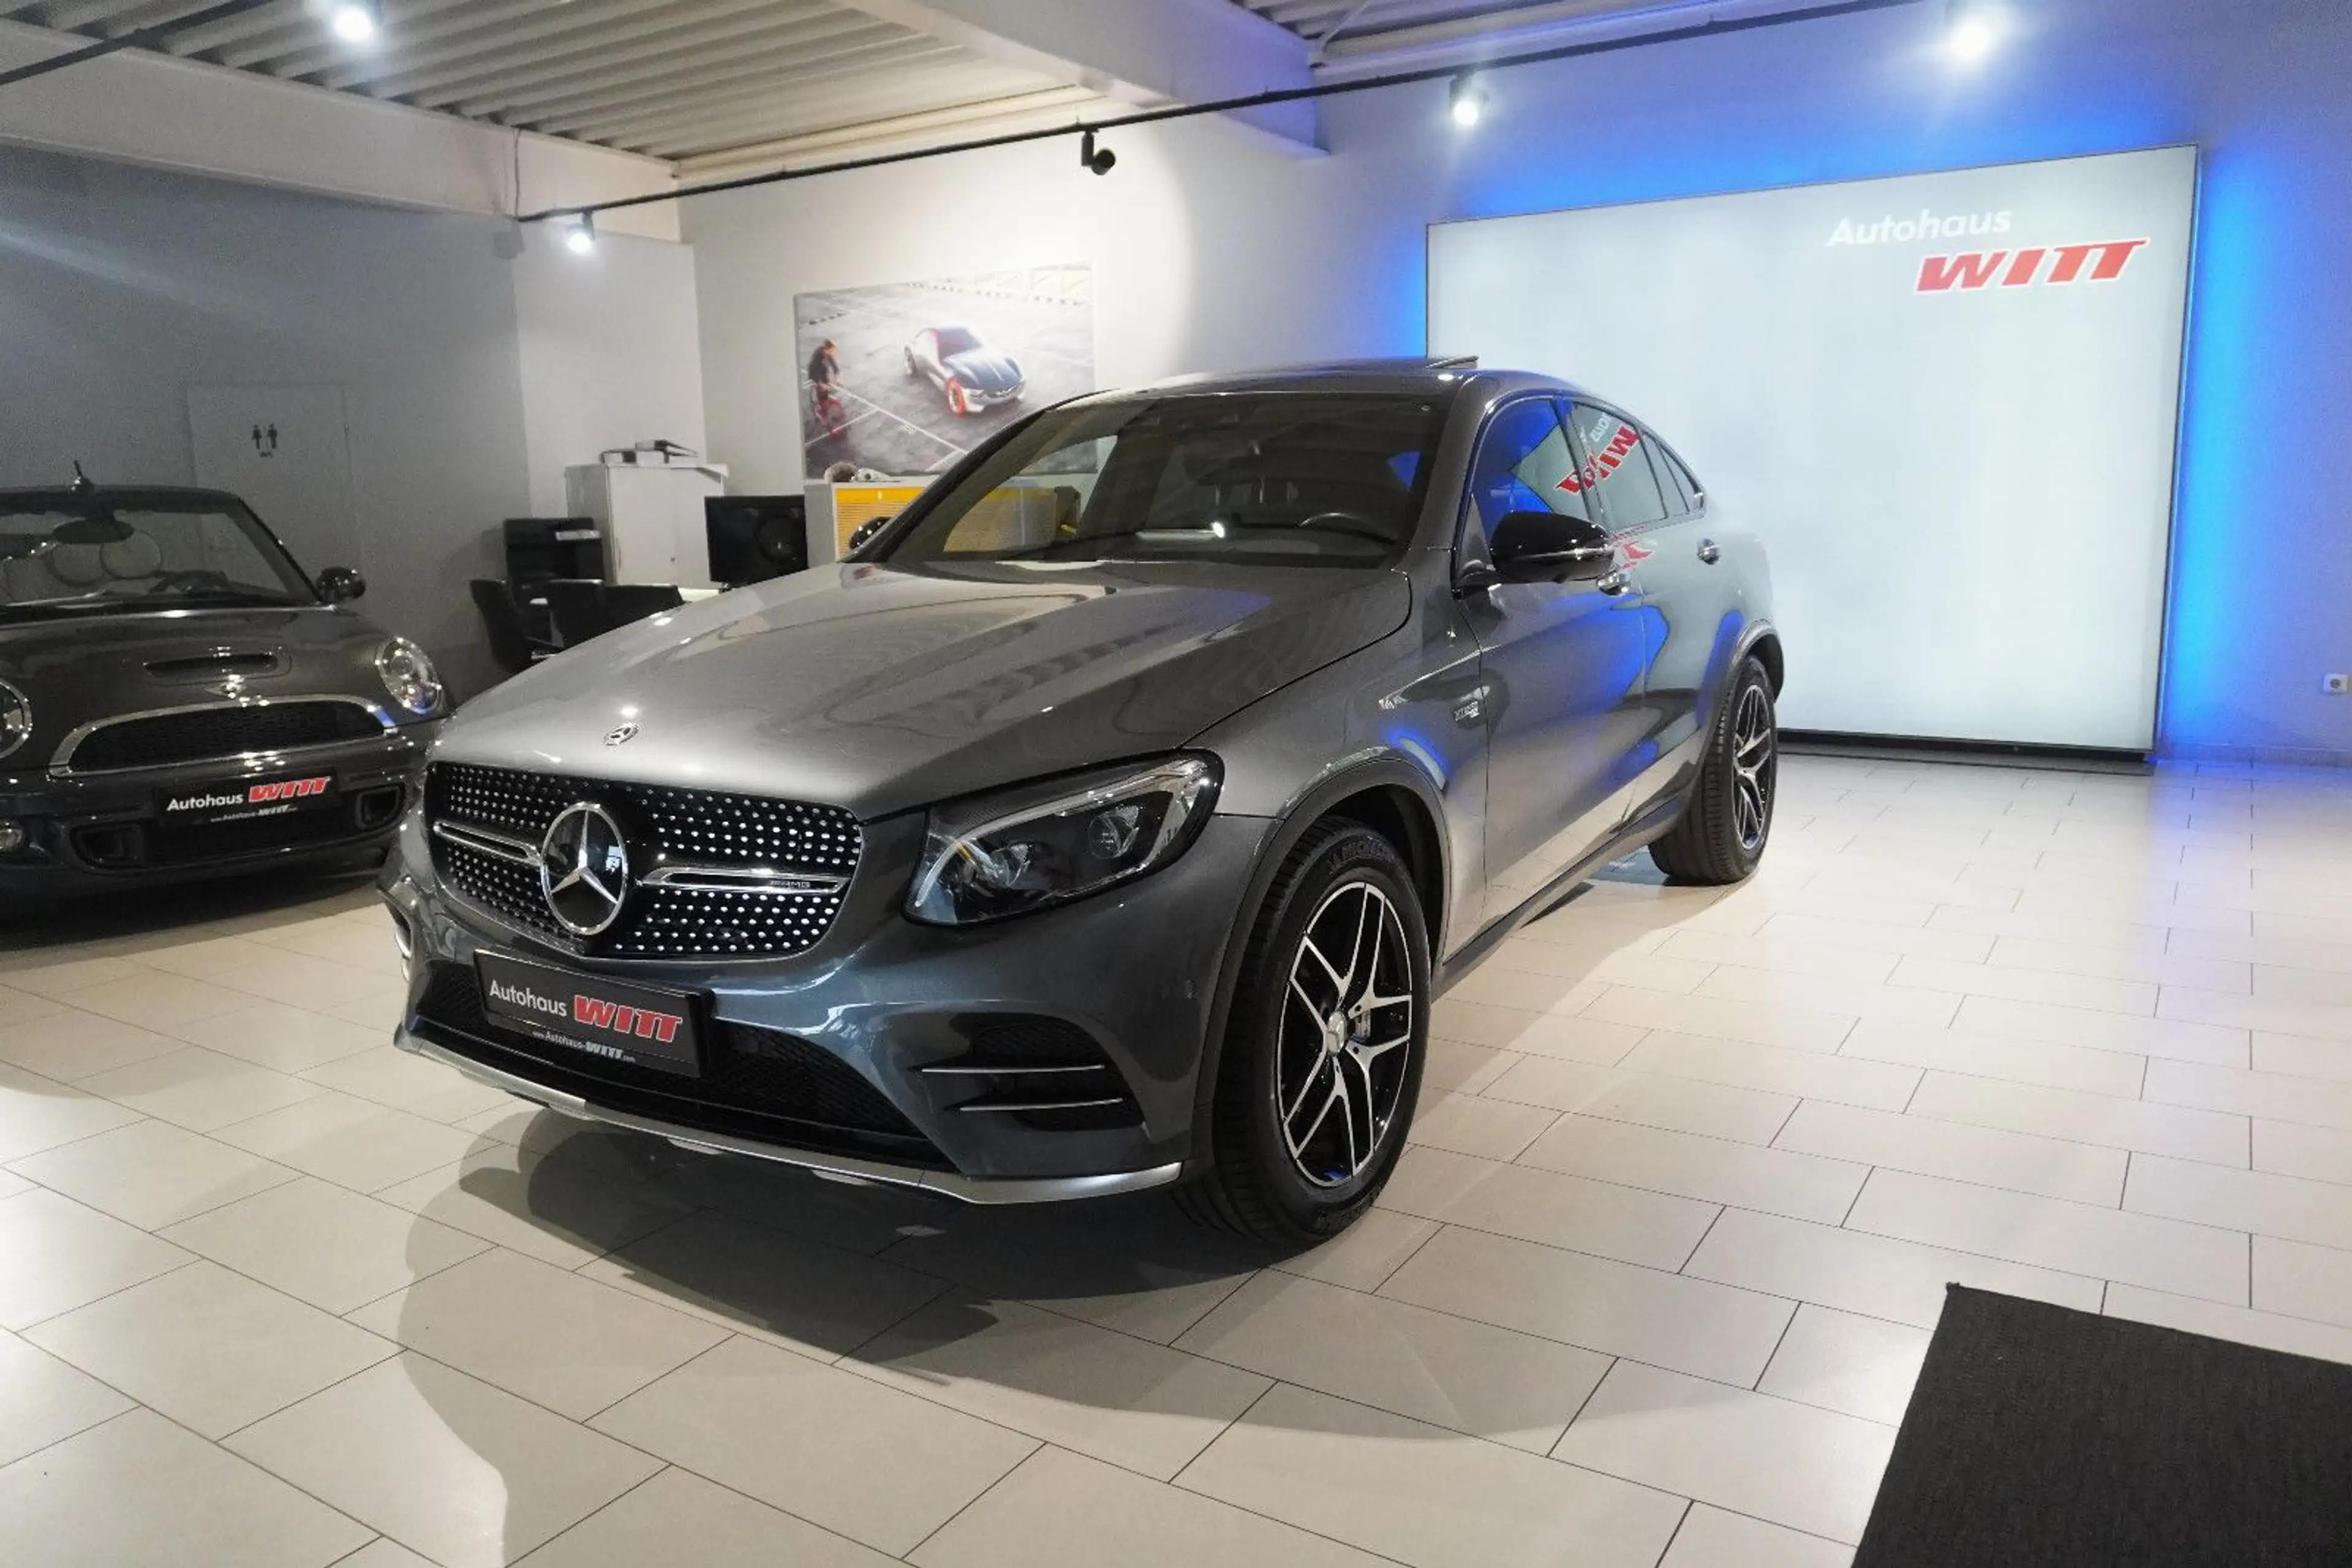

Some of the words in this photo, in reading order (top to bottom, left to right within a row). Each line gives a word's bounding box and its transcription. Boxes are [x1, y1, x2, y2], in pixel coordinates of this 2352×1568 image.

[1826, 209, 2012, 246] Autohaus
[1913, 237, 2150, 295] WITT
[167, 793, 244, 812] Autohaus
[248, 776, 333, 803] WITT
[489, 979, 567, 1017] Autohaus
[574, 995, 682, 1042] WITT
